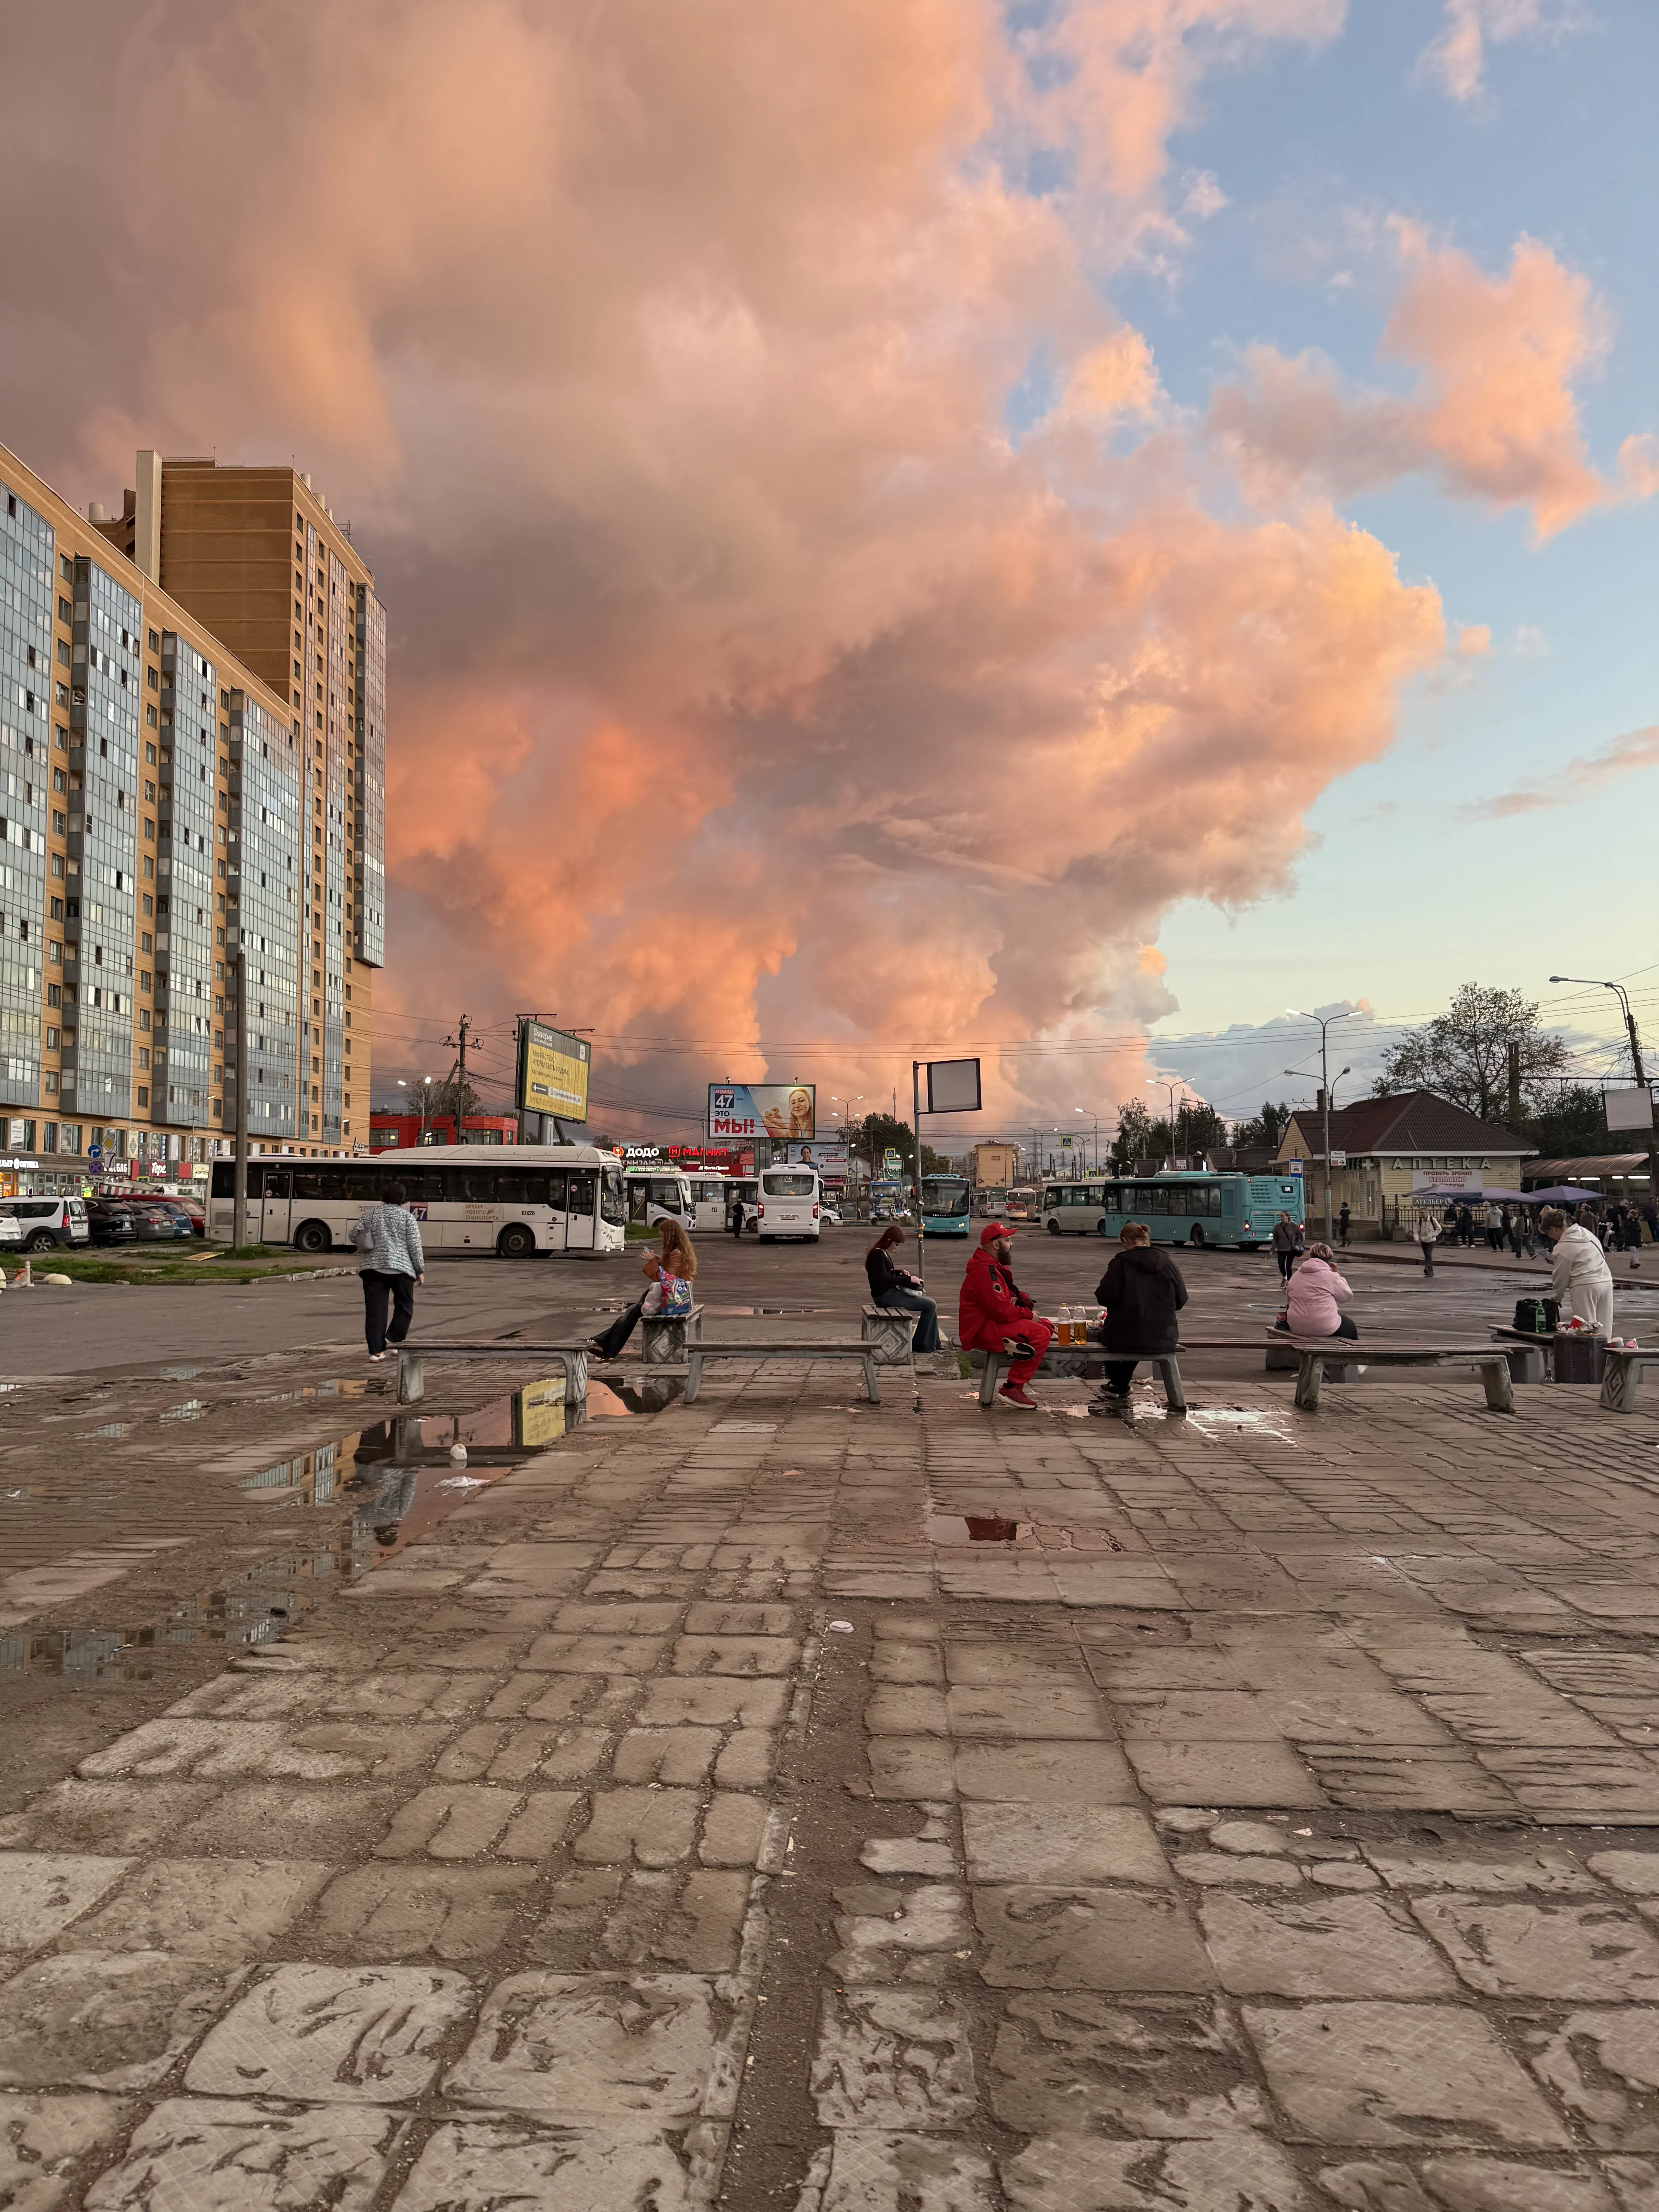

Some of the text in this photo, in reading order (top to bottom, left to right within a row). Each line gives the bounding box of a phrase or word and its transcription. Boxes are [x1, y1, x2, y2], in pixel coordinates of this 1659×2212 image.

[716, 1095, 733, 1108] 47
[714, 1118, 754, 1133] МЫ!
[626, 1148, 659, 1158] ДОДО
[1393, 1158, 1491, 1169] АПТЕКА
